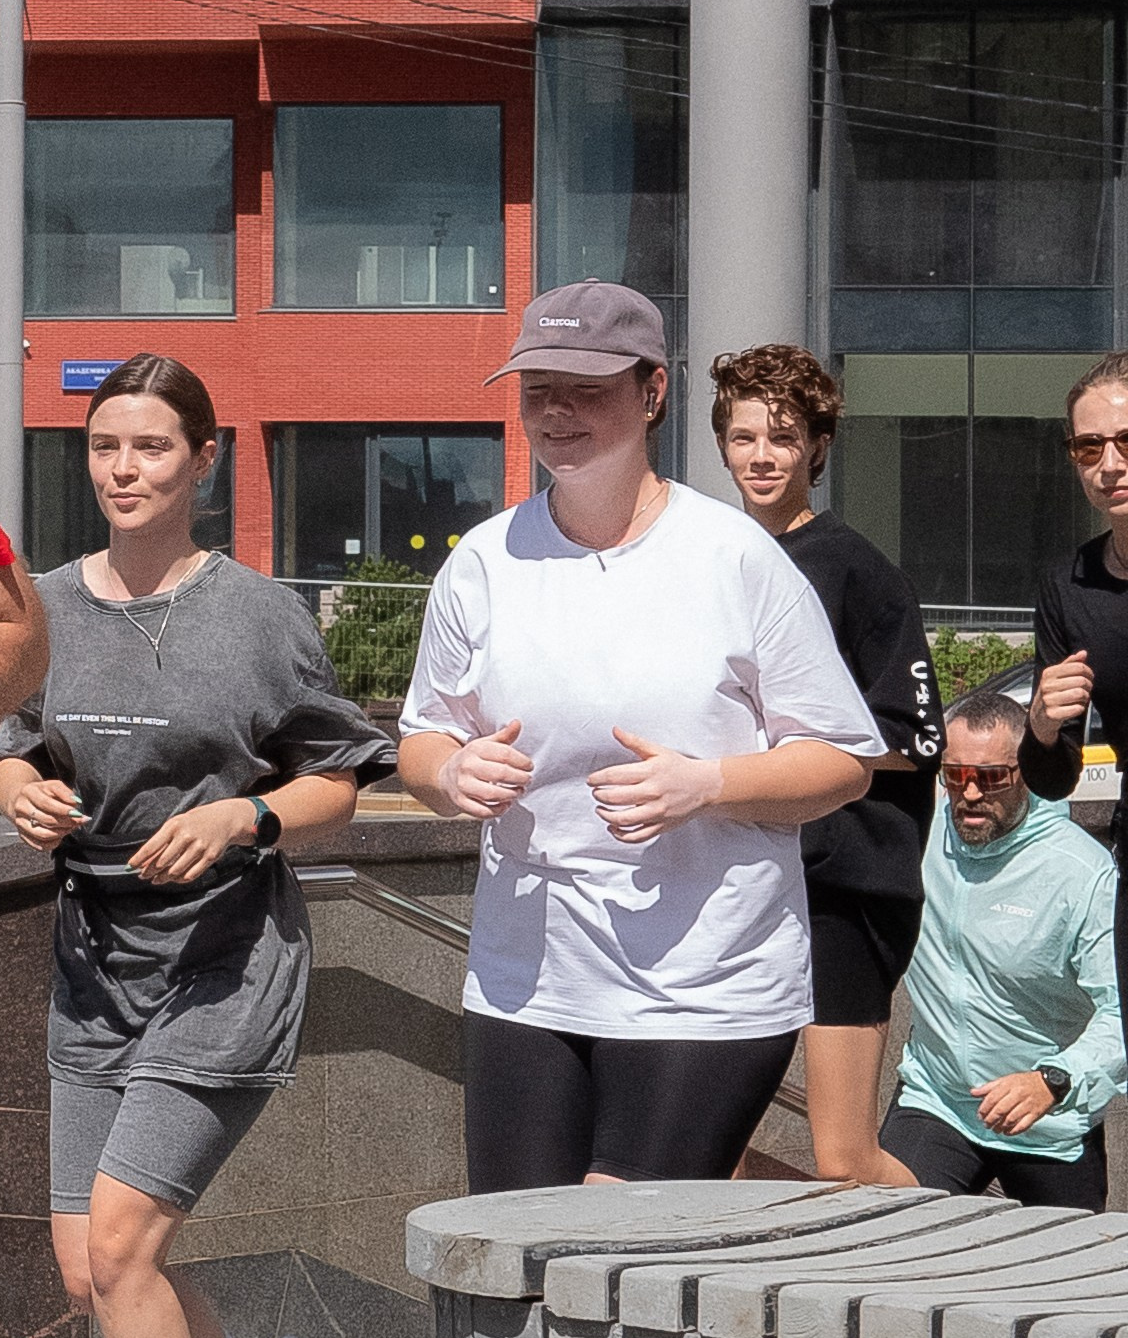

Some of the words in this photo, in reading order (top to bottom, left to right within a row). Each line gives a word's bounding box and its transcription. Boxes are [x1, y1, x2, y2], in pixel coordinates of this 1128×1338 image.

[68, 713, 81, 722] DAY
[81, 714, 100, 722] EVEN
[100, 714, 116, 723] THIS
[116, 715, 132, 724] WILL
[141, 717, 170, 726] HISTORY
[1085, 767, 1107, 781] 100
